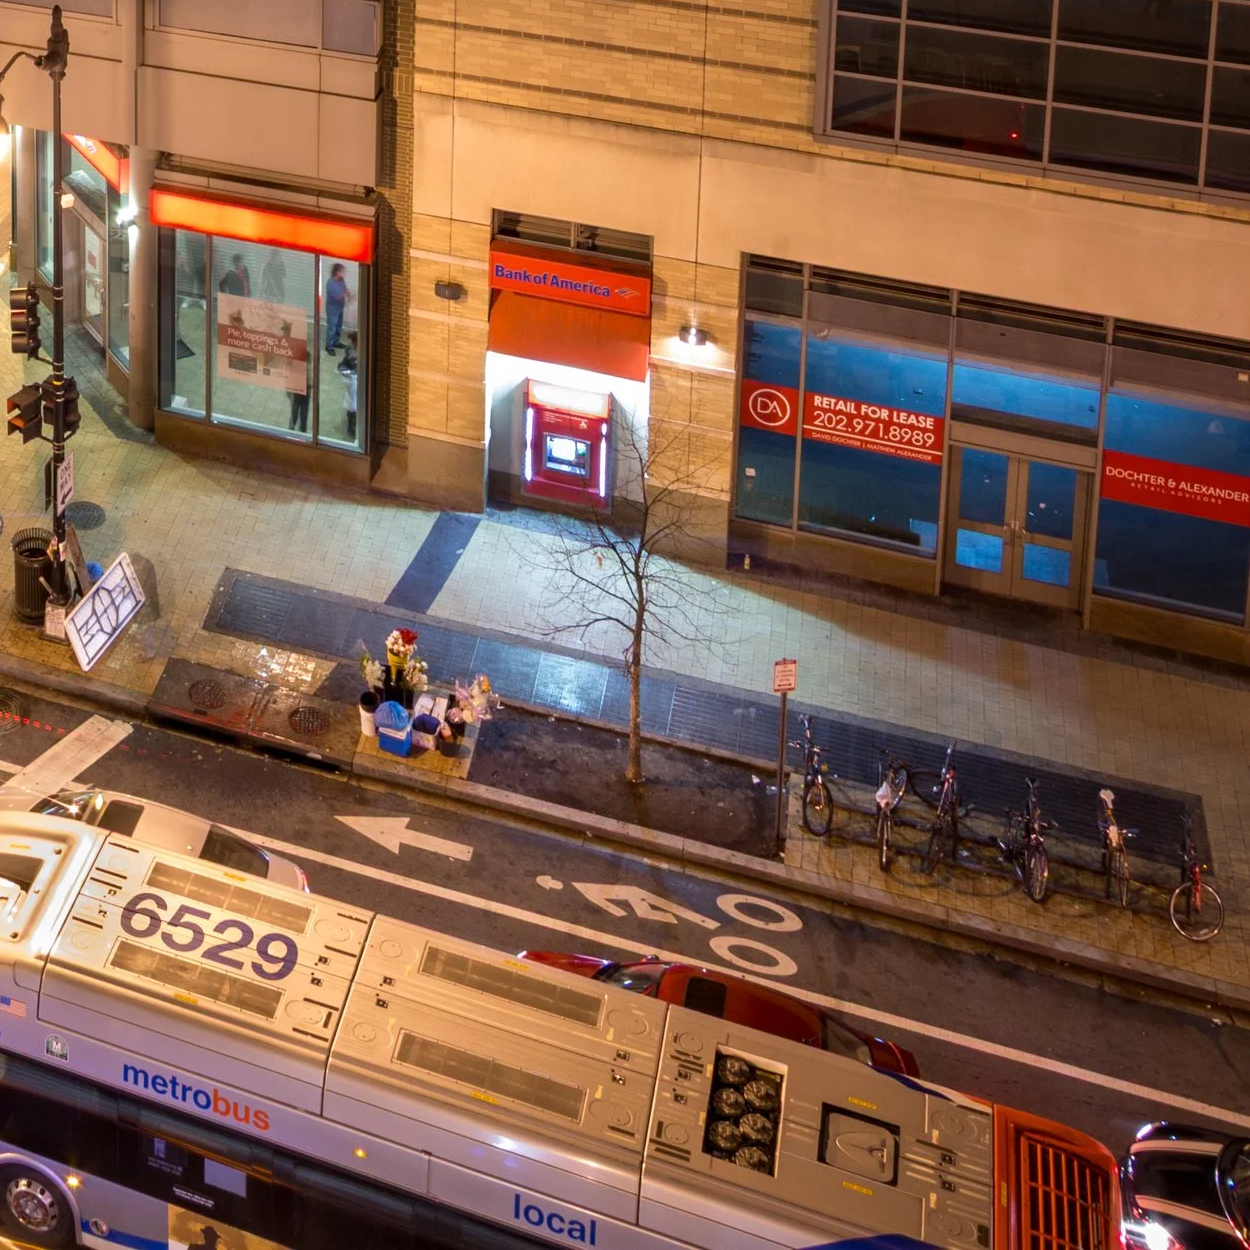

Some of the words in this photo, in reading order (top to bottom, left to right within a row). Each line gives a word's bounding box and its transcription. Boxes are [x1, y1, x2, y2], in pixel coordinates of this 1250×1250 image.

[494, 264, 531, 283] Bank
[533, 273, 548, 285] of
[549, 275, 610, 297] America
[227, 327, 243, 339] Pie,
[243, 331, 279, 347] toppings
[280, 339, 289, 347] &
[227, 338, 250, 349] more
[252, 342, 272, 352] cash
[273, 345, 294, 357] back
[813, 410, 935, 448] 202.971.8989
[814, 395, 857, 414] RETAIL
[860, 404, 889, 421] FOR
[893, 410, 934, 430] LEASE
[811, 431, 832, 441] DAVID
[832, 435, 861, 448] DOCHTER
[896, 448, 932, 461] ALEXANDER
[60, 457, 72, 480] ONE
[60, 472, 72, 493] WAY
[1106, 466, 1166, 487] DOCHTER
[1167, 478, 1177, 488] &
[1178, 481, 1250, 503] ALEXANDER
[1130, 482, 1166, 494] RETAIL
[1170, 490, 1222, 505] ADVISORS
[120, 892, 299, 981] 6529
[123, 1063, 271, 1132] metrobus
[513, 1193, 597, 1246] local
